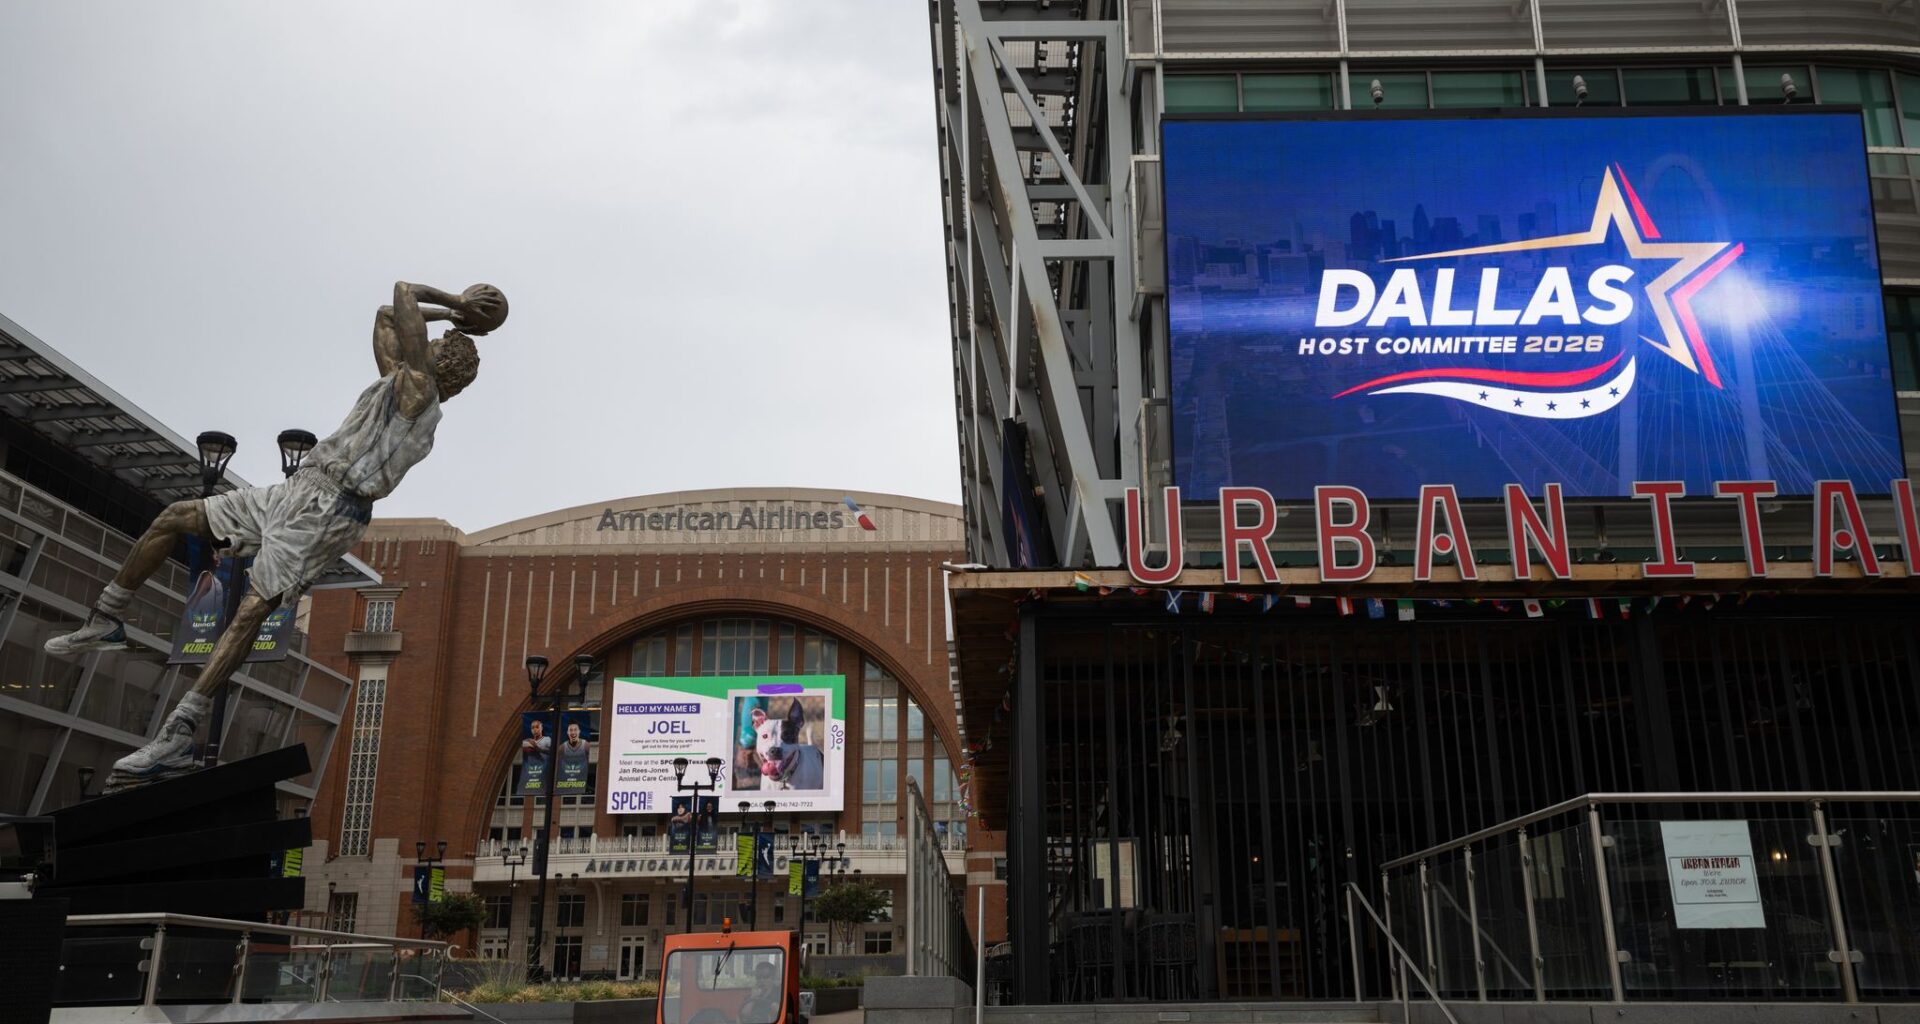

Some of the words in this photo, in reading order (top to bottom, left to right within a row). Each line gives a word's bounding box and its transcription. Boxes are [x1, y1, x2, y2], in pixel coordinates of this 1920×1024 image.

[1314, 264, 1636, 327] DALLAS
[1298, 337, 1370, 355] HOST
[1375, 336, 1518, 355] COMMITTEE
[1523, 335, 1605, 353] 2026
[596, 507, 733, 532] American
[737, 505, 844, 530] Airlines
[1124, 482, 1571, 584] URBAN
[182, 642, 215, 654] KUIER
[251, 641, 276, 650] FUDD
[618, 705, 648, 713] HELLO!
[649, 705, 663, 713] MY
[647, 720, 691, 734] JOEL
[611, 791, 646, 811] SPCA
[585, 858, 682, 873] AMERICAN
[1681, 857, 1710, 870] URBAN
